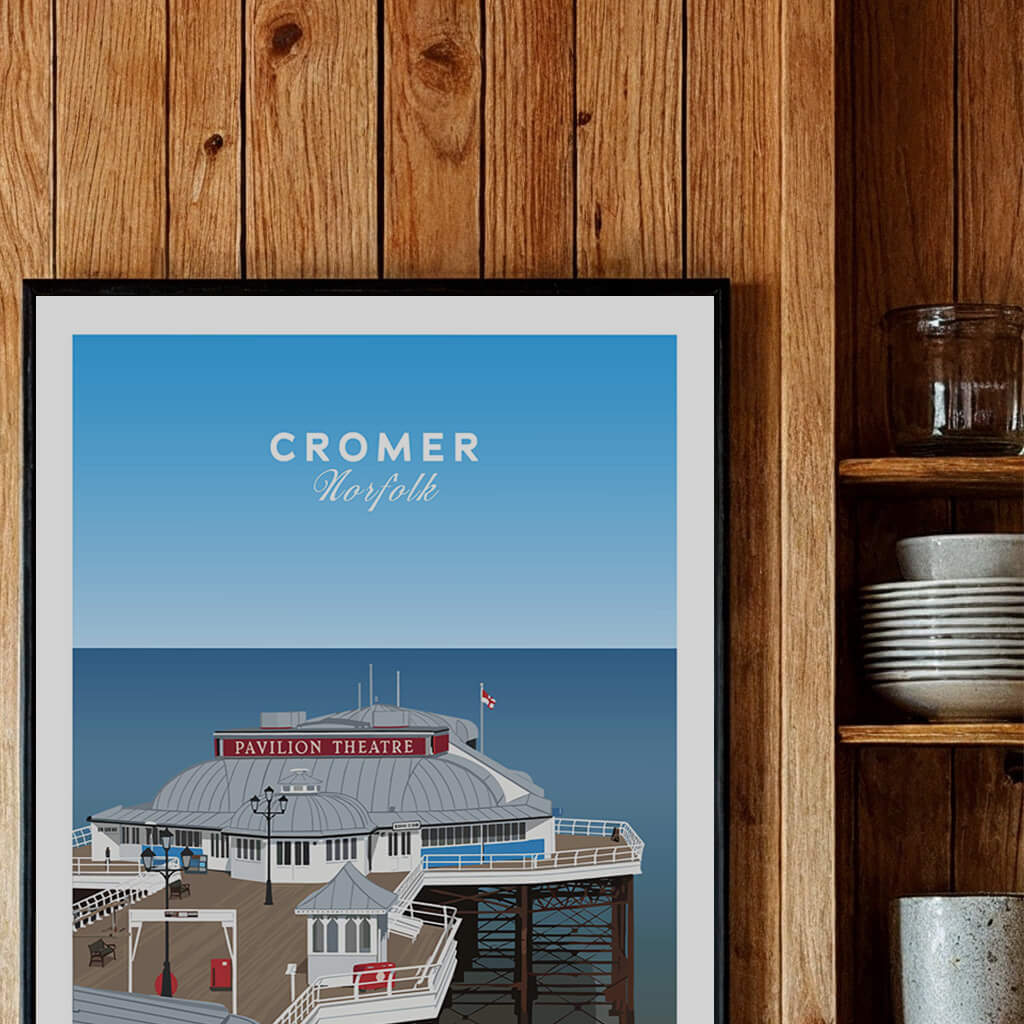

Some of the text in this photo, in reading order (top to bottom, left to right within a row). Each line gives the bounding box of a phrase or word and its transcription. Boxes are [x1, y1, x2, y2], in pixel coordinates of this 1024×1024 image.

[270, 431, 479, 462] CROMER
[313, 468, 440, 512] Norfolk
[235, 739, 414, 755] PAVILION THEATRE
